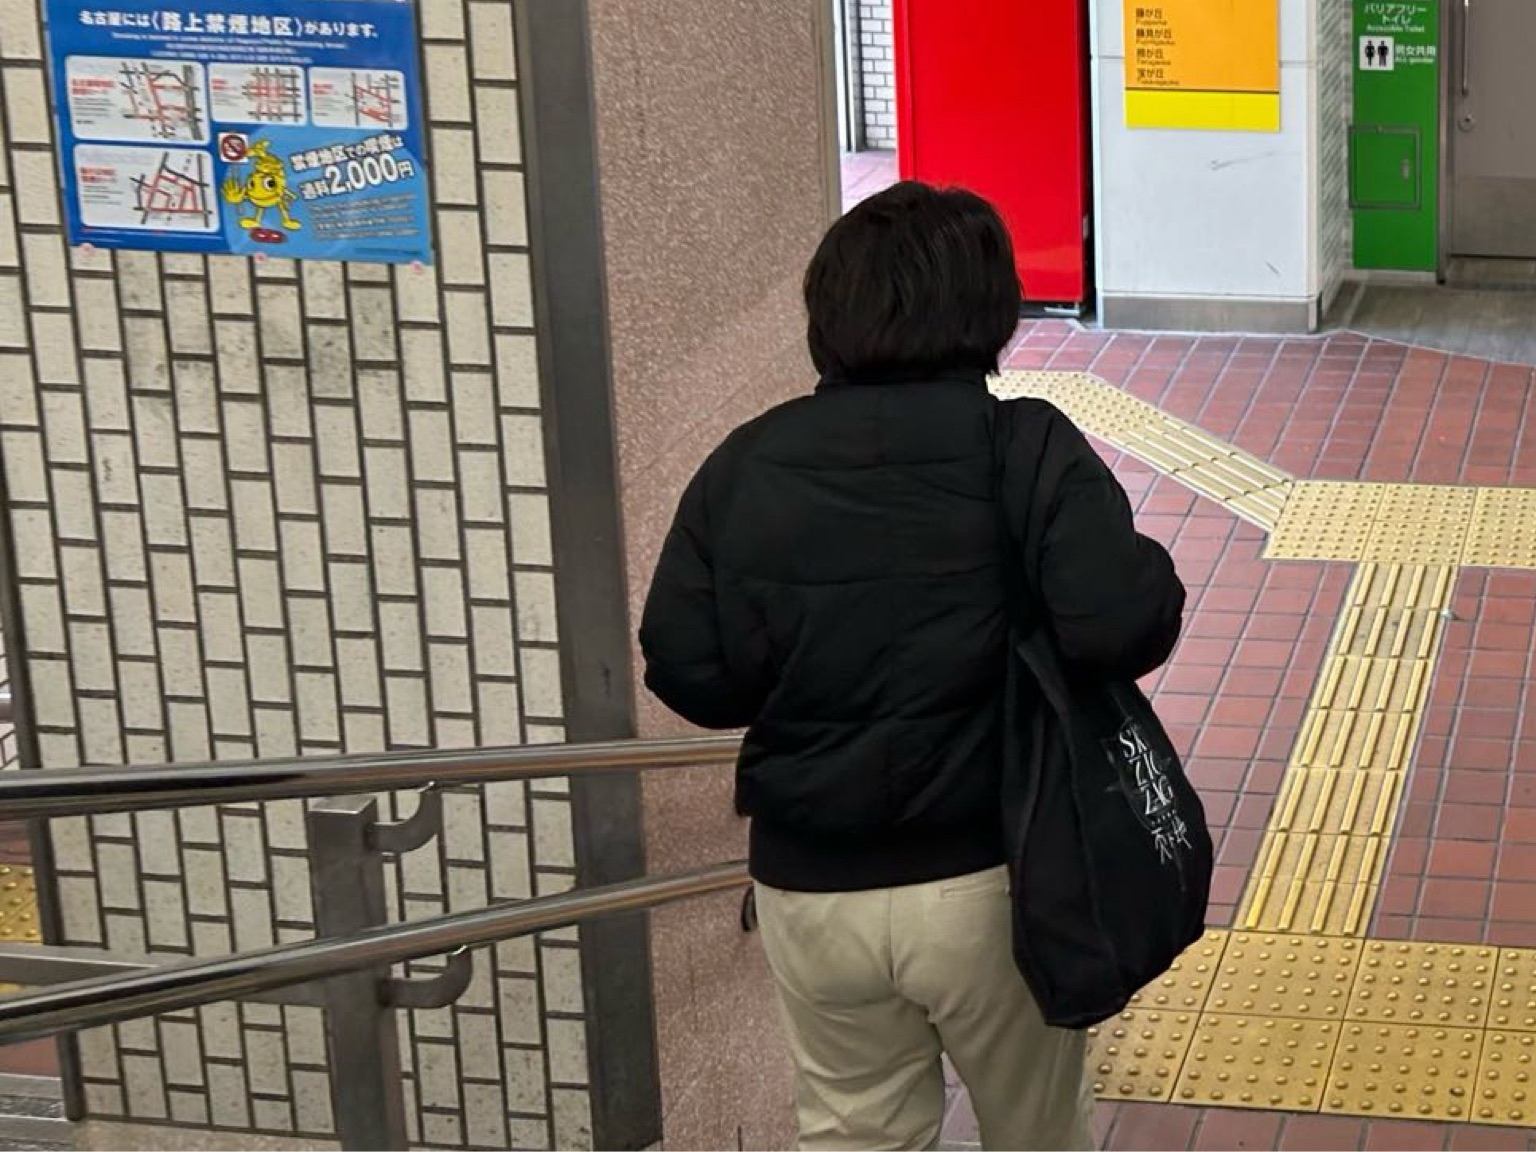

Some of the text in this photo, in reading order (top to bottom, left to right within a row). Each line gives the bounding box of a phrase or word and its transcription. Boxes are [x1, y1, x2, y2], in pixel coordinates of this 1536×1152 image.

[1364, 2, 1427, 15] バリアフリー
[1382, 14, 1412, 25] トイレ
